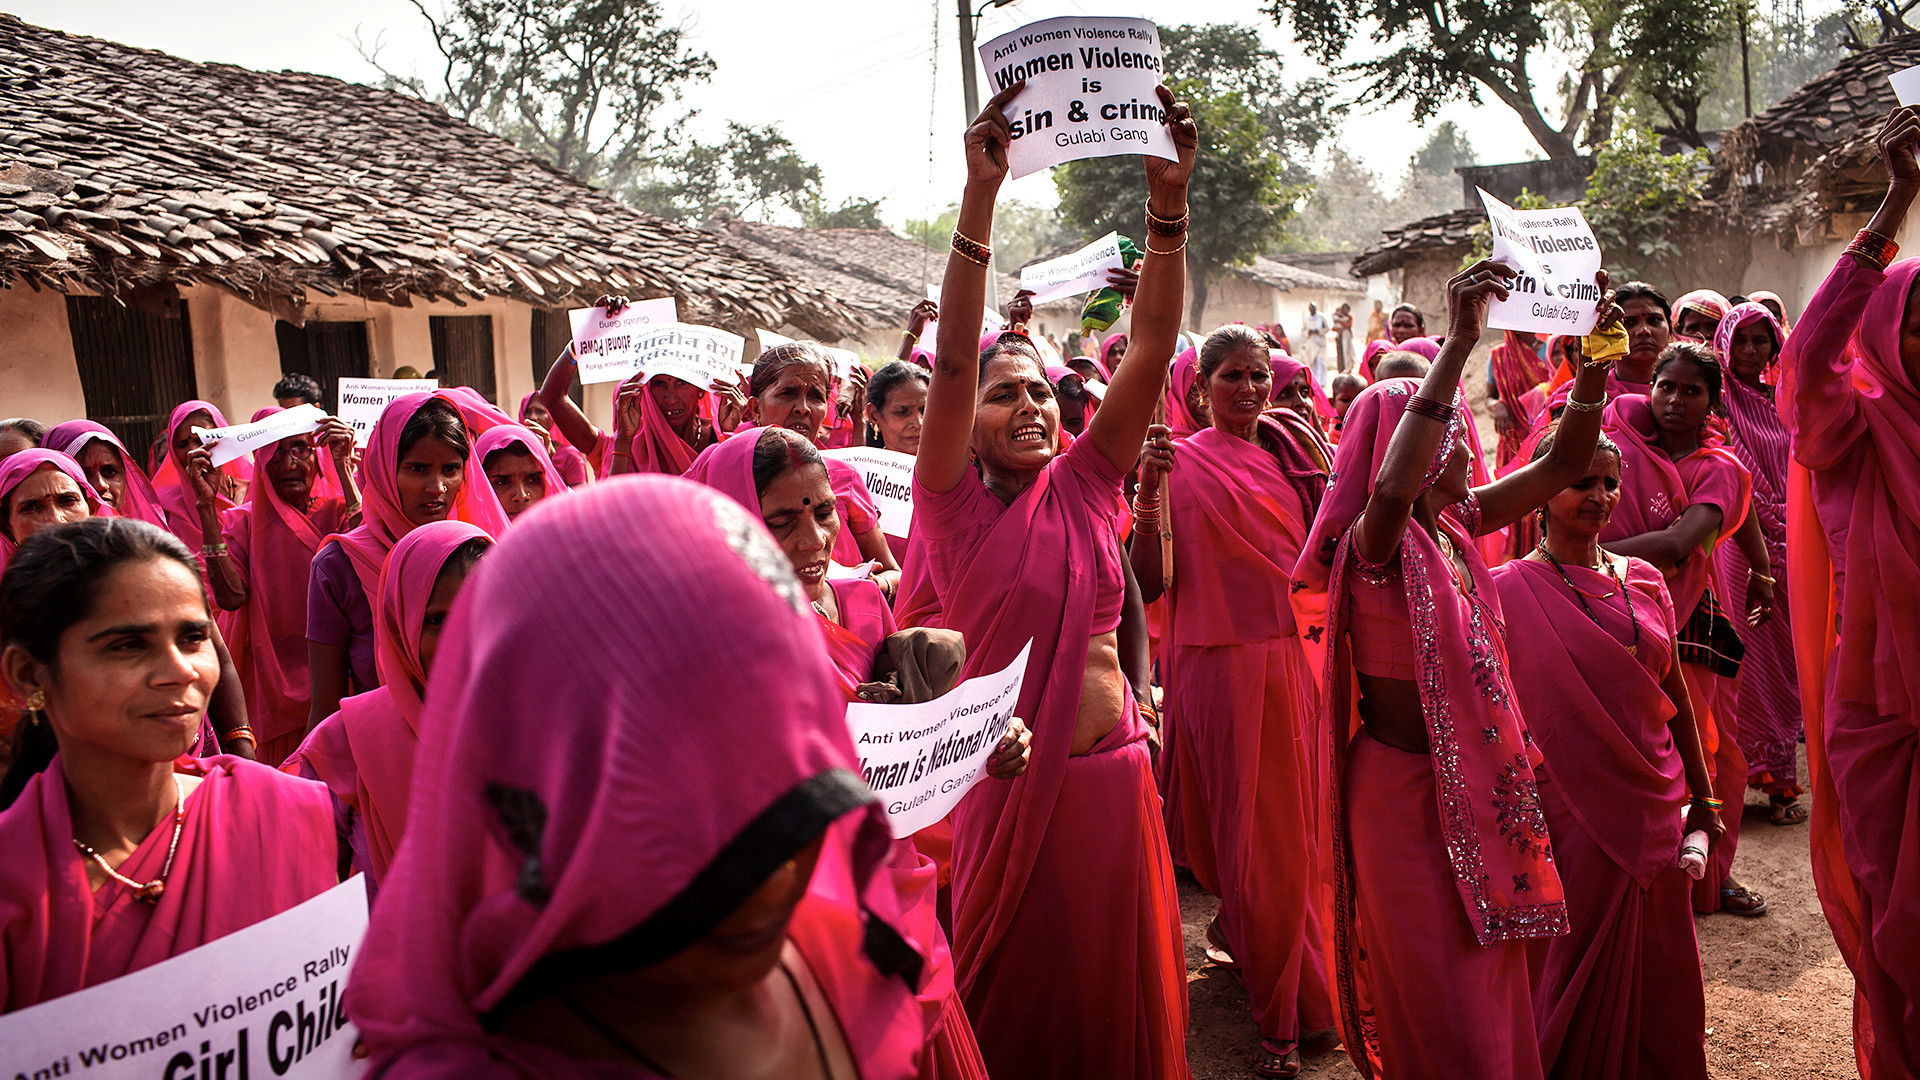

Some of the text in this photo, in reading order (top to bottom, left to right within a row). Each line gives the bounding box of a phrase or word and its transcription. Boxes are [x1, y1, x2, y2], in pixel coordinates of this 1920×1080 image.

[993, 27, 1153, 62] Anti Women Violence Rally
[994, 46, 1161, 91] Women Violence
[1082, 77, 1102, 93] is
[1008, 98, 1166, 140] sin & crime
[1055, 127, 1149, 147] Gulabi Gang
[1553, 216, 1578, 227] Rally
[1080, 245, 1116, 267] Violence
[1526, 234, 1594, 254] Violence
[1503, 270, 1536, 294] sin
[1557, 278, 1600, 302] crime
[599, 320, 621, 330] Gang
[1531, 302, 1580, 324] Gulabi Gang
[580, 333, 631, 357] ational Power
[342, 393, 383, 406] Women
[853, 456, 889, 467] Violence
[892, 461, 912, 474] Rally
[866, 471, 911, 502] Violence
[858, 732, 893, 744] Anti
[898, 718, 947, 742] Women
[949, 694, 1001, 721] Violence
[909, 748, 927, 784] is
[925, 718, 989, 776] National
[888, 768, 976, 815] Gulabi Gang
[79, 1023, 187, 1069] Women
[193, 975, 297, 1029] Violence
[303, 943, 350, 983] Rally
